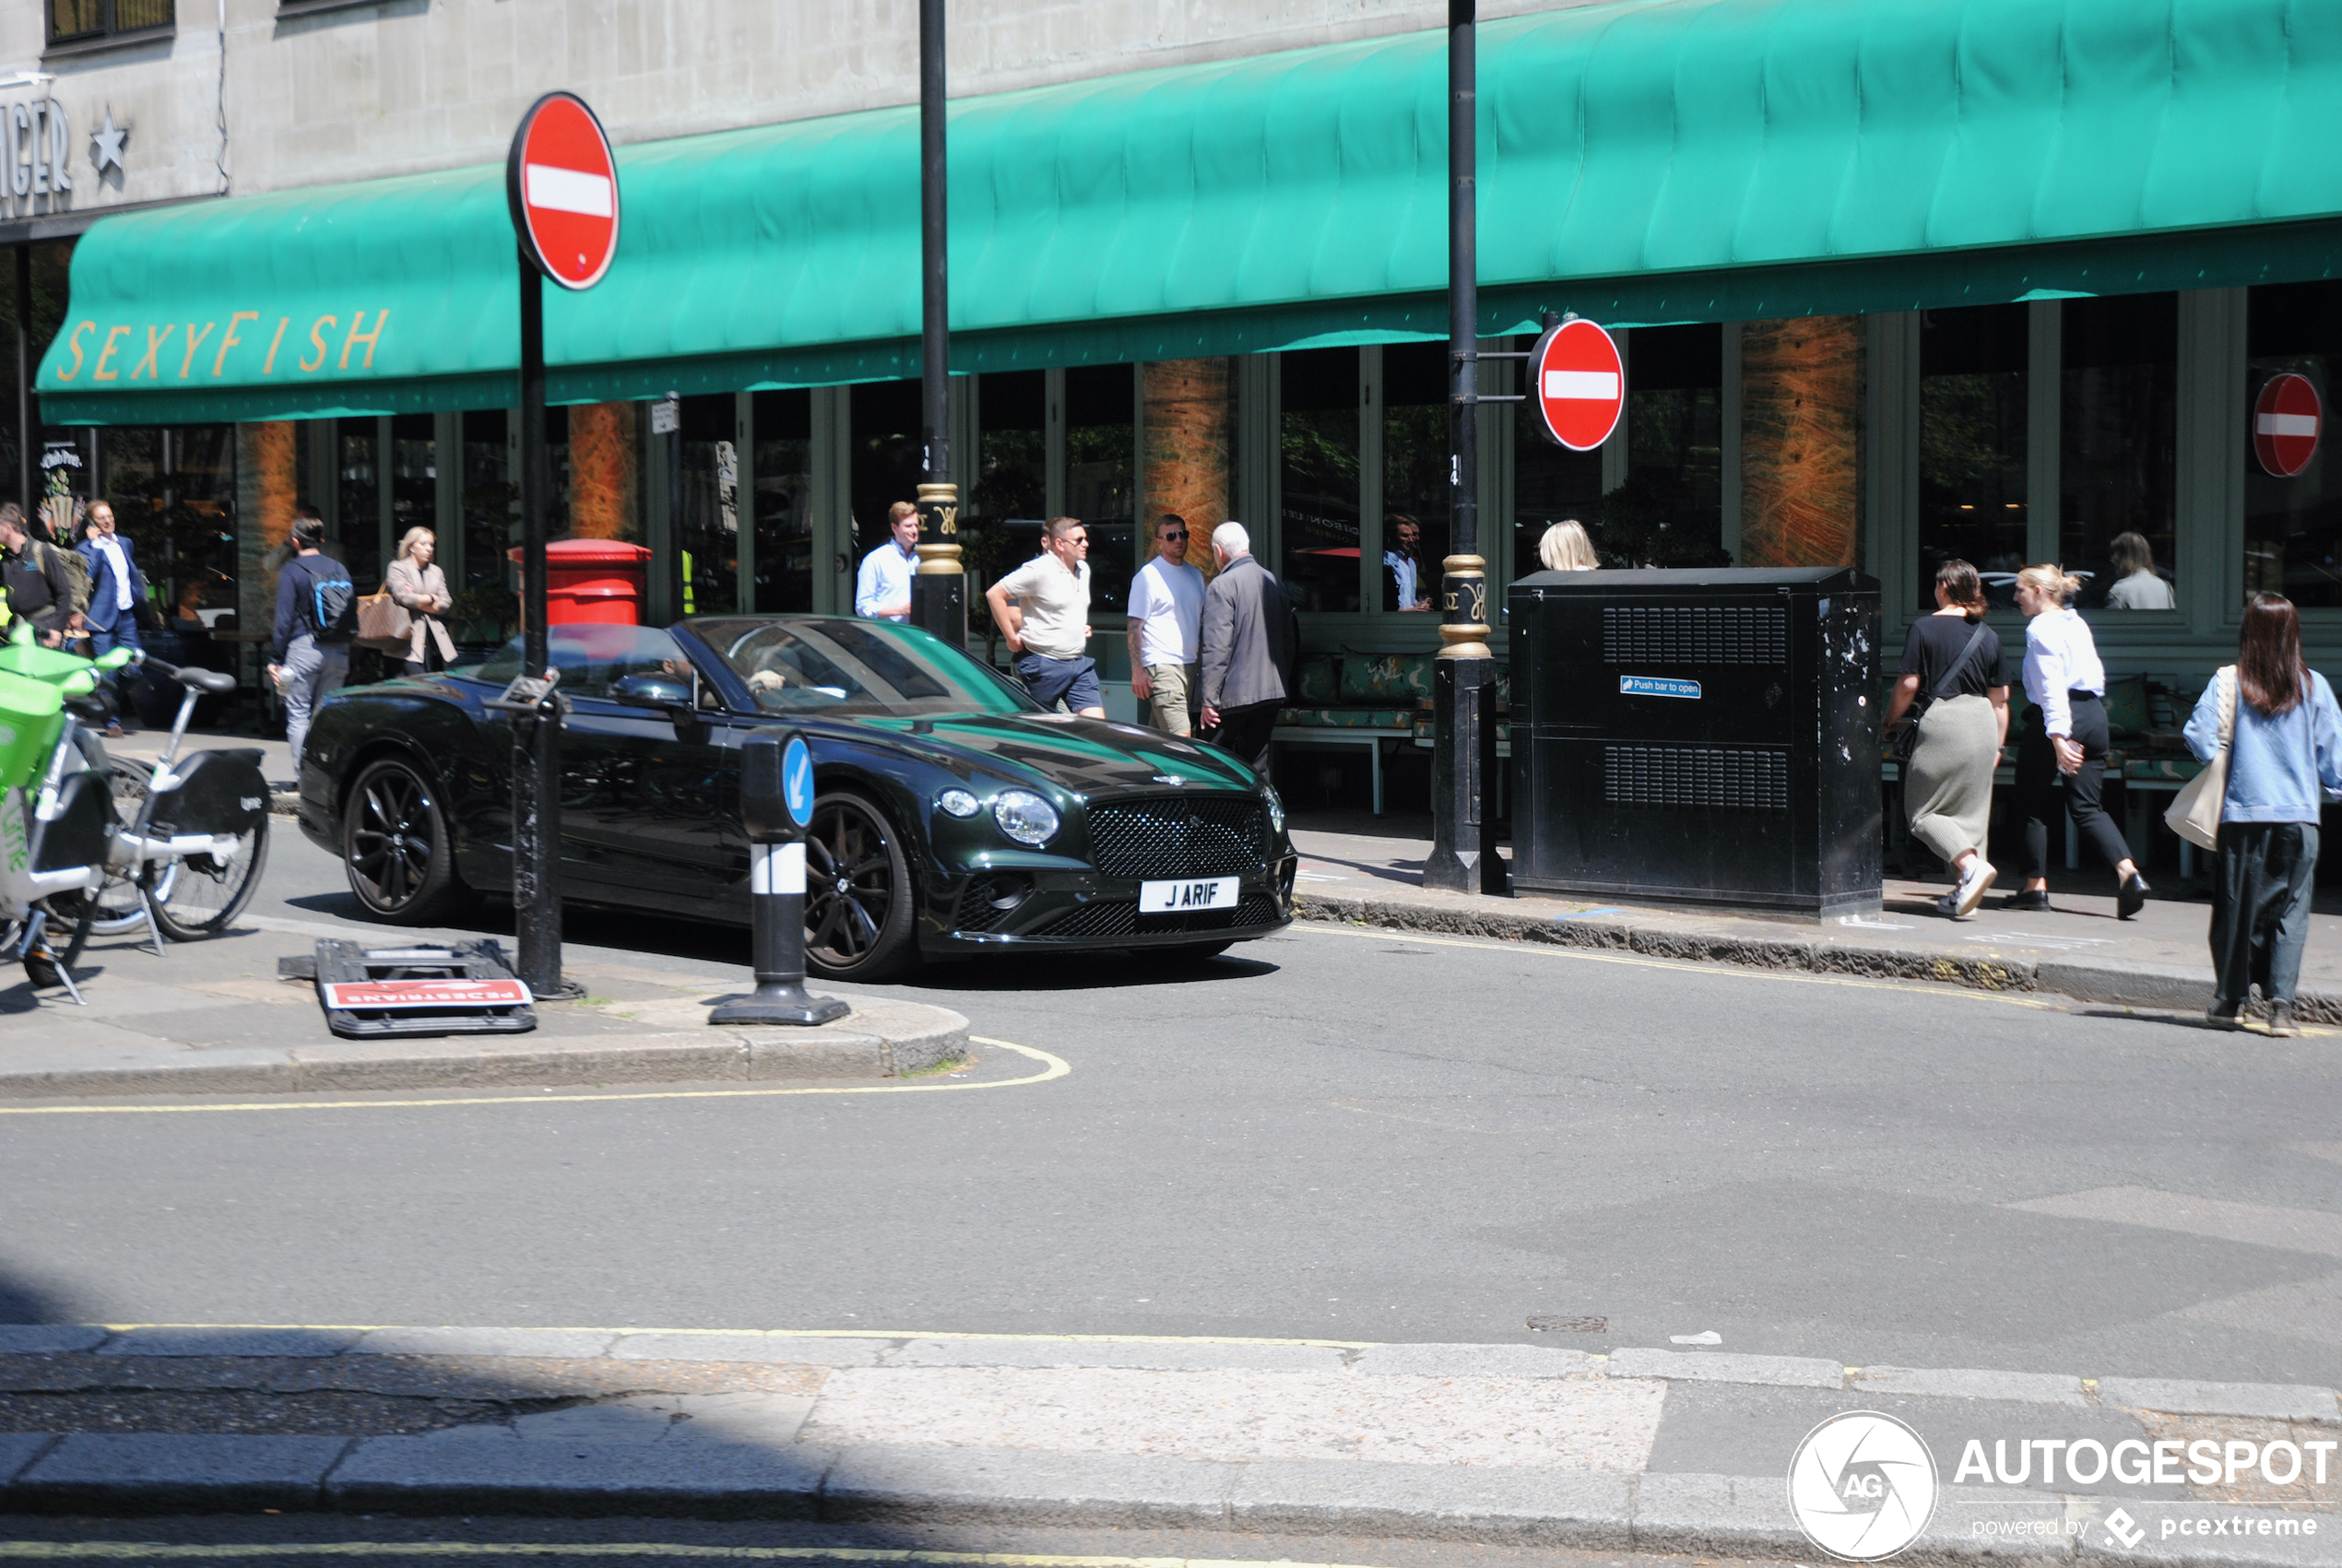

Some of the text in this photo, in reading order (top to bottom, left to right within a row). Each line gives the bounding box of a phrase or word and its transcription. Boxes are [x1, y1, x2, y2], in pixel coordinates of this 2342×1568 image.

[1635, 679, 1697, 694] Push bar to open
[1165, 882, 1218, 906] J ARIF
[346, 991, 515, 1003] PEDESTRIANS
